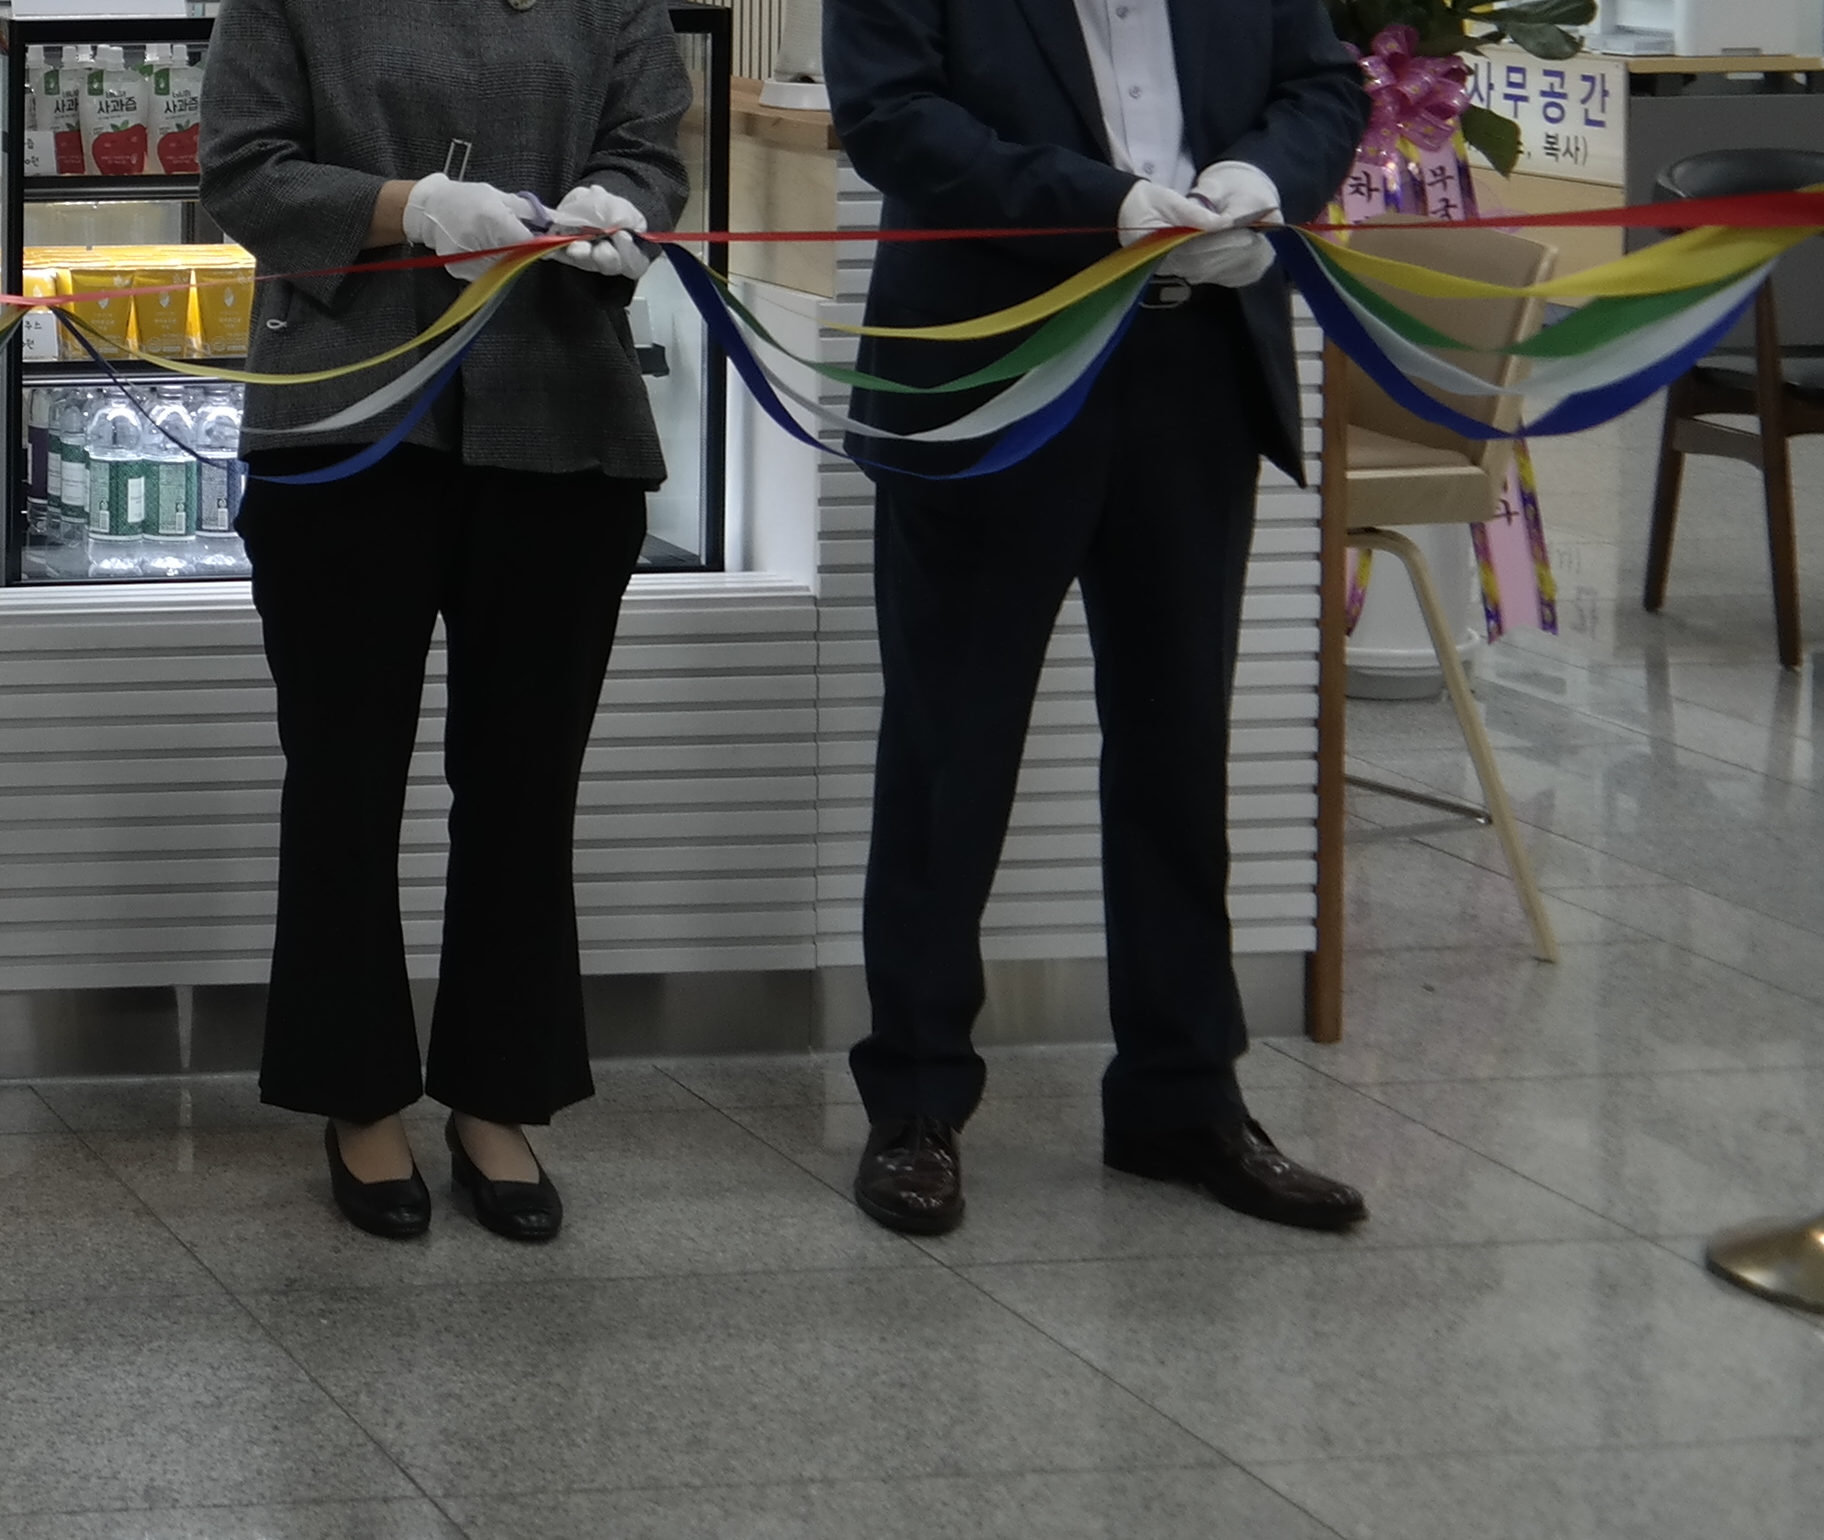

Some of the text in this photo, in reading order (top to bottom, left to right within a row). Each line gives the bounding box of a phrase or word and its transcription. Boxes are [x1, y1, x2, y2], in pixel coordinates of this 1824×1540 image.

[97, 96, 138, 114] 사과즙
[163, 96, 199, 114] 사과즙
[1469, 60, 1610, 129] 사무공간
[1543, 132, 1588, 166] 복사)
